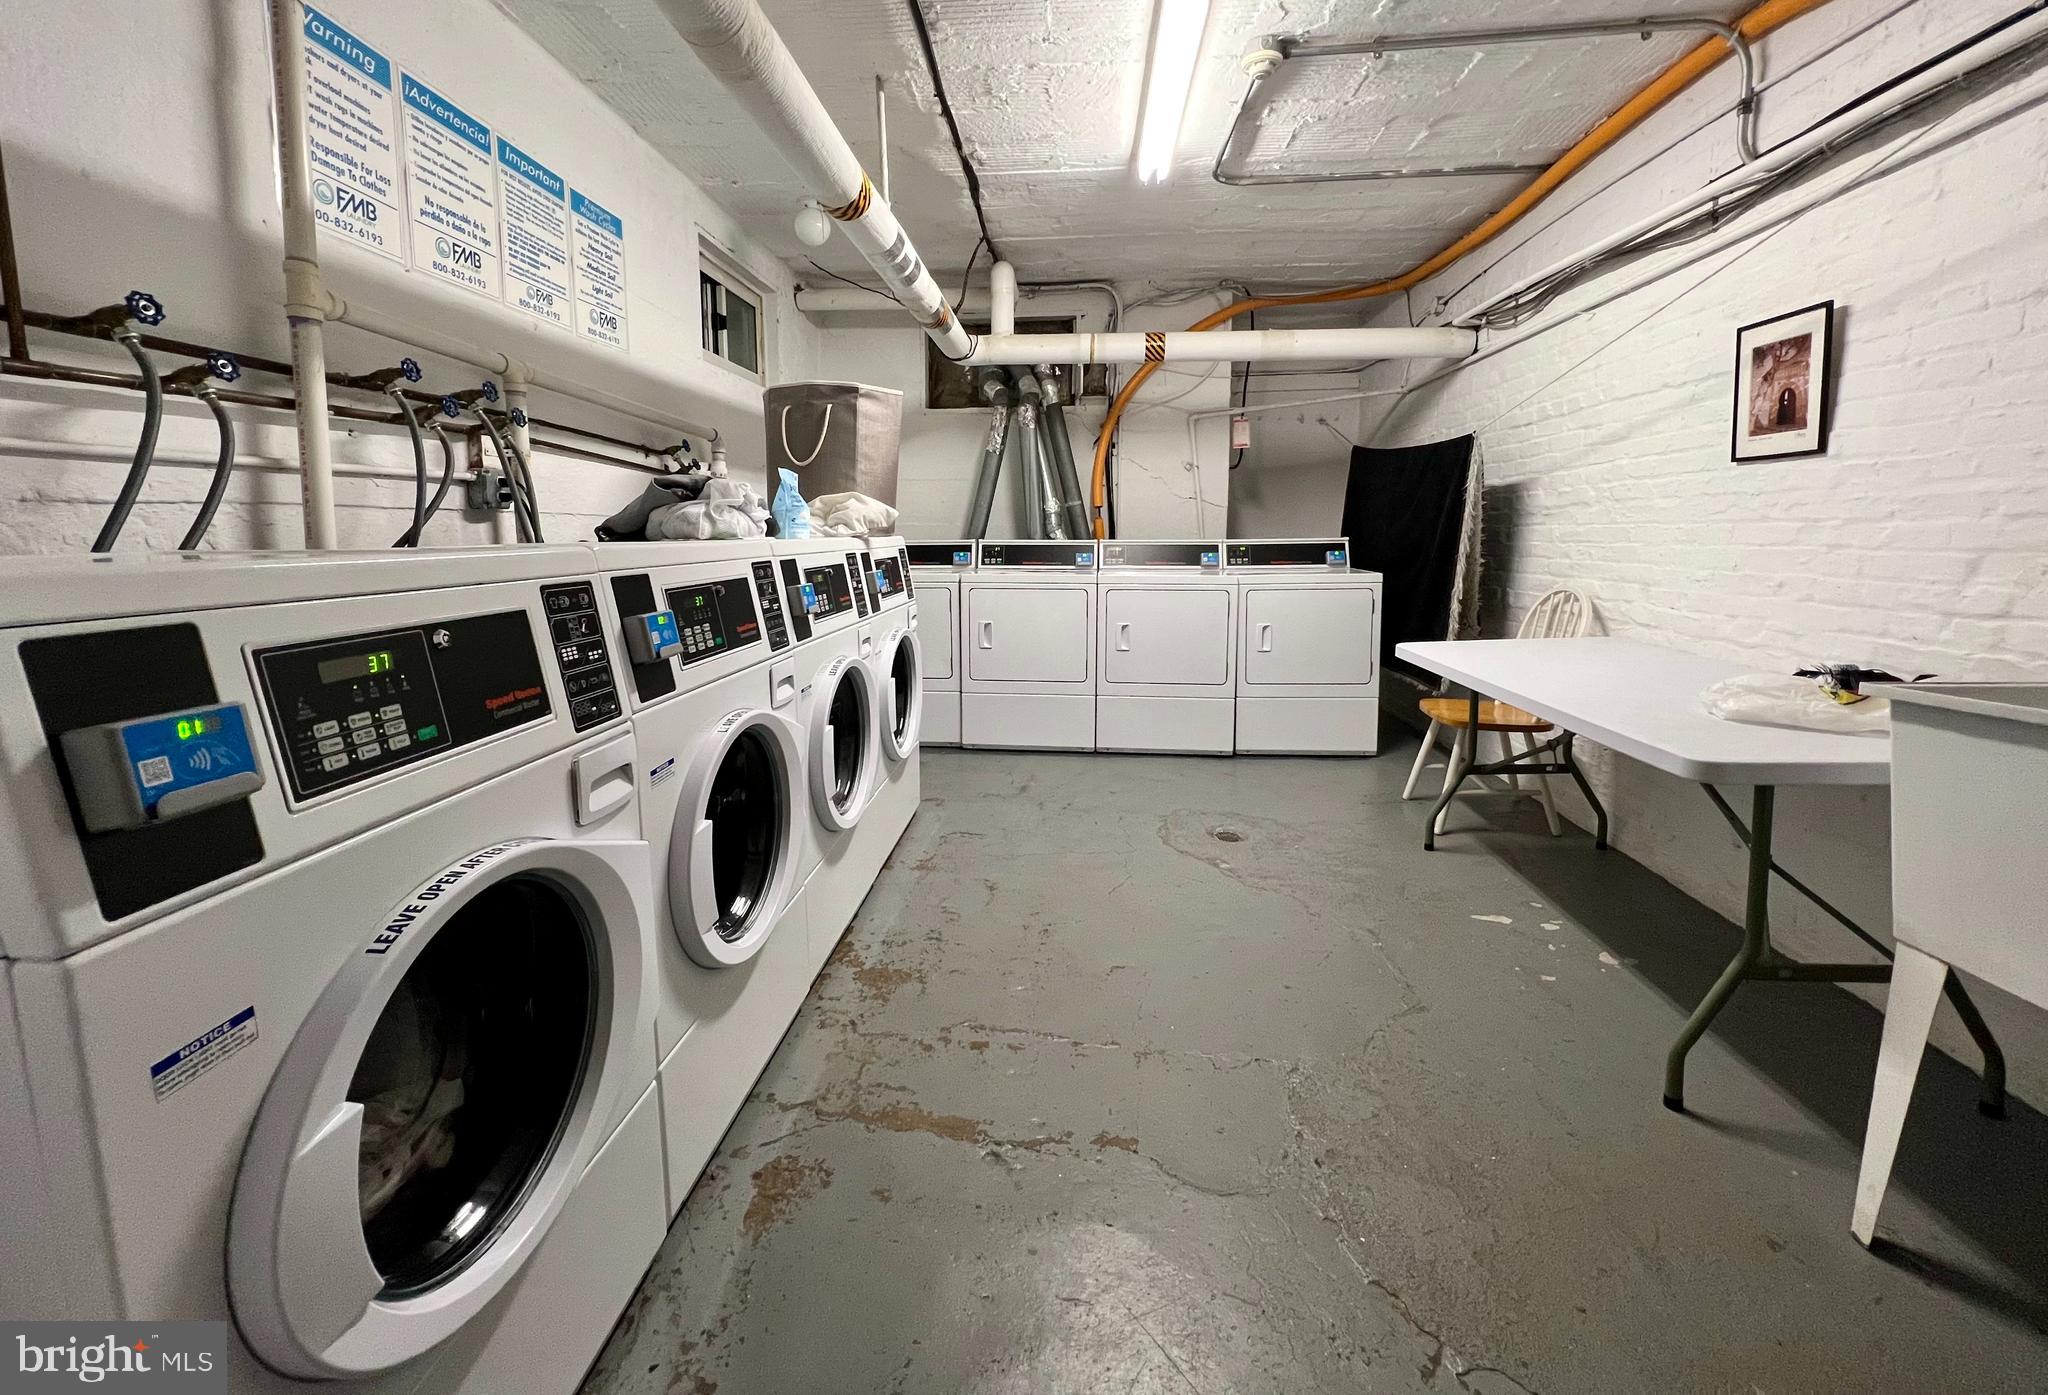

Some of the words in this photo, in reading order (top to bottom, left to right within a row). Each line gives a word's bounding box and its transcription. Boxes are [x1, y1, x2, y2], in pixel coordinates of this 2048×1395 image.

[311, 150, 345, 177] Damage
[347, 168, 357, 182] To
[359, 175, 386, 197] Clothes
[375, 169, 391, 186] Loss
[505, 146, 560, 192] Important
[336, 186, 377, 222] FMB
[424, 195, 434, 208] No
[315, 209, 383, 246] 00-832-6193
[452, 242, 482, 269] FMB
[432, 260, 486, 289] 800-832-6193
[535, 288, 553, 306] FMB
[599, 311, 617, 330] FMB
[368, 653, 390, 673] 37
[365, 904, 427, 955] LEAVE
[417, 870, 468, 901] OPEN
[460, 847, 510, 870] AFTER
[179, 1021, 232, 1059] NOTICE
